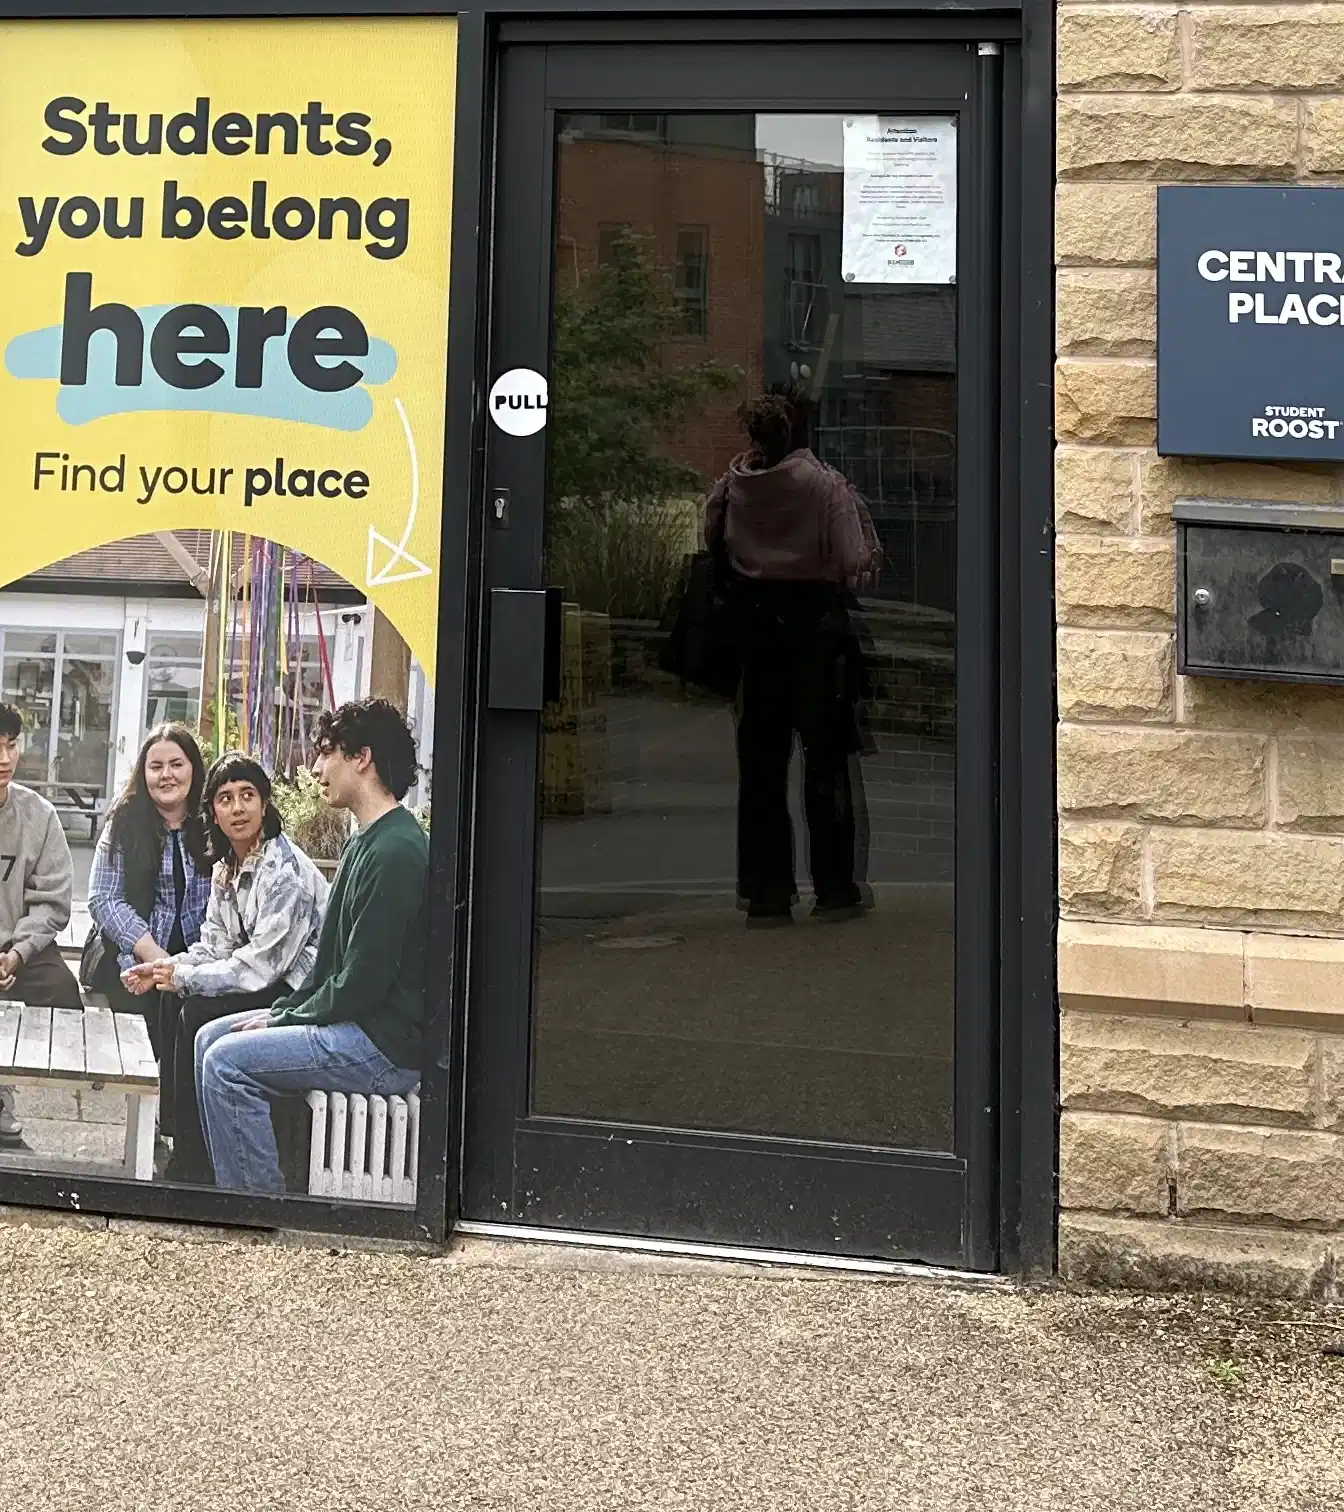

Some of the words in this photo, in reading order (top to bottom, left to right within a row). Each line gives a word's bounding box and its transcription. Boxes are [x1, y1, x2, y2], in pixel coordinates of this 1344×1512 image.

[42, 96, 393, 167] Students,
[15, 195, 144, 257] you
[161, 180, 410, 260] belong
[59, 271, 369, 392] here
[494, 395, 547, 411] PULL
[1252, 418, 1340, 440] ROOST
[1264, 406, 1325, 419] STUDENT
[33, 452, 126, 493] Find
[137, 464, 233, 505] your
[244, 458, 370, 506] place
